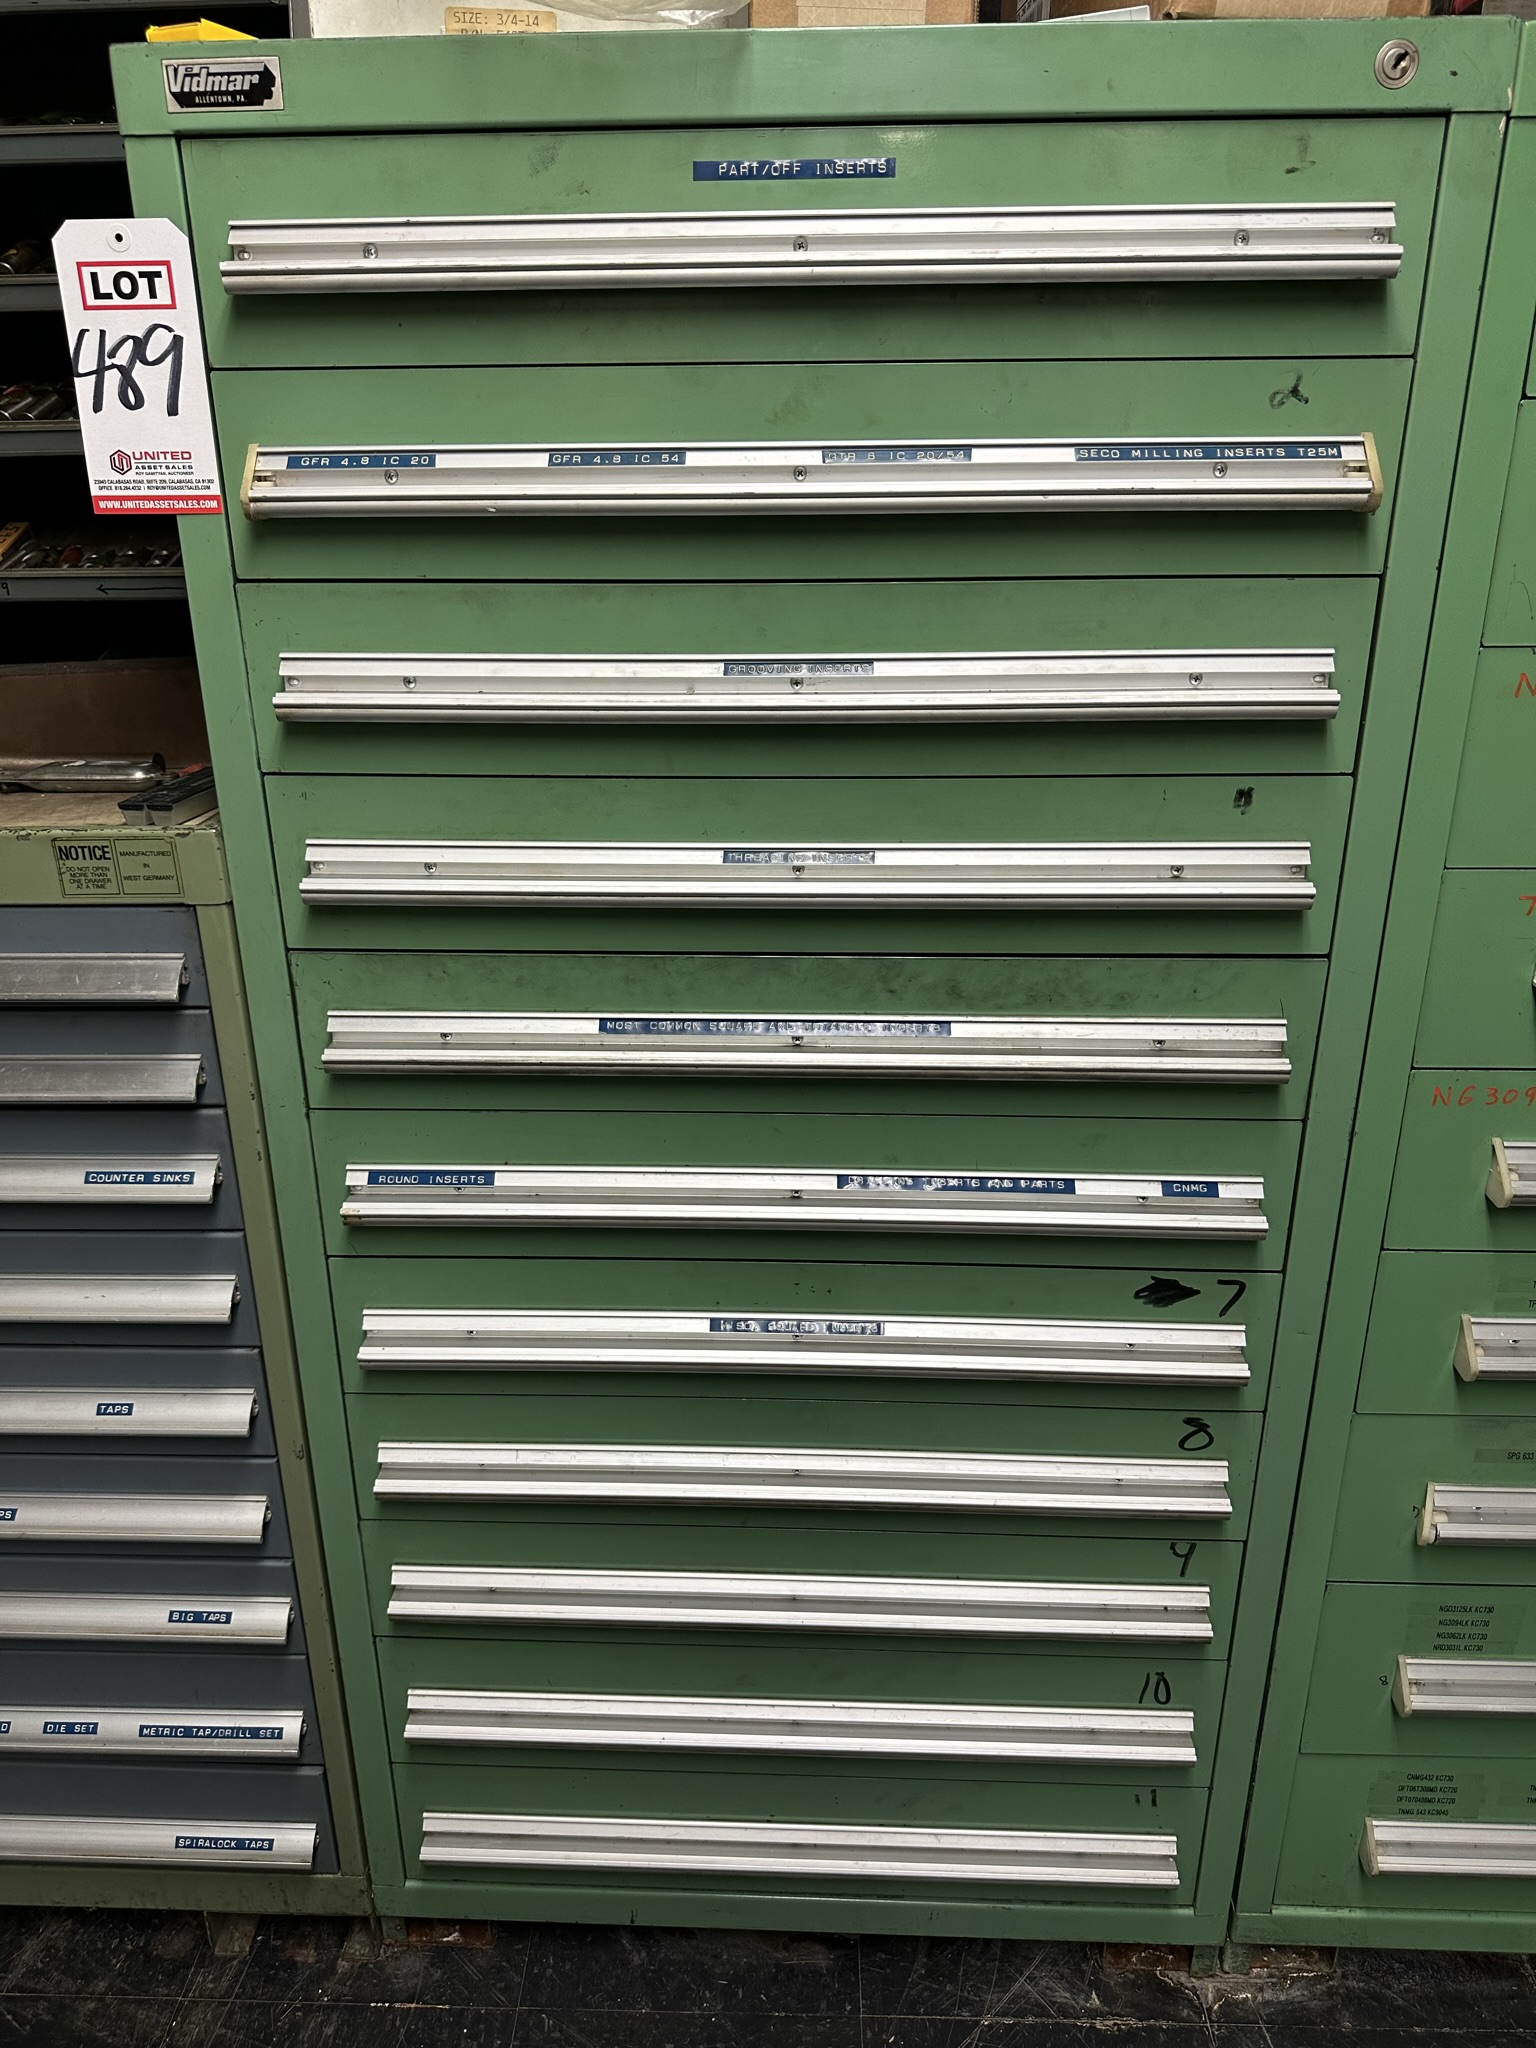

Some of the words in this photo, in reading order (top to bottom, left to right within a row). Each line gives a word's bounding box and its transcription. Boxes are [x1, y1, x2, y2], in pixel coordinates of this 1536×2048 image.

[453, 11, 488, 25] SIZE:
[497, 13, 540, 27] 3/4-14
[166, 63, 260, 93] Vidmar
[195, 95, 235, 104] ALLENTOWN,
[236, 94, 248, 103] PA.
[719, 162, 801, 176] PART/OFF
[816, 160, 888, 175] INSERTS
[91, 271, 162, 300] LOT
[73, 323, 184, 416] 489
[132, 451, 193, 460] UNITED
[867, 451, 876, 460] 6
[889, 451, 906, 460] IC
[916, 450, 965, 460] 20/54
[1079, 449, 1120, 458] SECO
[1131, 448, 1203, 458] MILLING
[1216, 447, 1286, 457] INSERTS
[1297, 447, 1339, 457] T25M
[300, 457, 330, 466] GFR
[341, 457, 370, 466] 4.8
[382, 456, 400, 465] IC
[410, 456, 429, 465] 20
[552, 455, 581, 464] GFR
[593, 455, 622, 464] 4.8
[634, 454, 651, 463] IC
[661, 454, 679, 463] 54
[98, 500, 218, 509] WWW.UNITEDASSETSALES.COM
[728, 664, 802, 674] GROOVING
[58, 845, 112, 861] NOTICE
[607, 1021, 640, 1030] MOST
[650, 1021, 700, 1031] COMMON
[89, 1173, 145, 1183] COUNTER
[153, 1173, 191, 1183] SINKS
[378, 1175, 419, 1184] ROUND
[429, 1175, 485, 1184] INSERTS
[1021, 1179, 1066, 1190] PARTS
[1173, 1183, 1208, 1193] CNMG
[1217, 1279, 1247, 1317] 7
[100, 1404, 130, 1414] TAPS
[1178, 1417, 1215, 1451] 8
[1169, 1542, 1198, 1578] 9
[172, 1612, 195, 1622] BIG
[202, 1613, 227, 1622] TAPS
[1138, 1671, 1172, 1705] 10
[46, 1724, 67, 1733] DIE
[74, 1724, 95, 1733] SET
[142, 1727, 184, 1737] METRIC
[192, 1727, 252, 1738] TAP/DRILL
[259, 1729, 280, 1738] SET
[178, 1839, 237, 1849] SPIRALOCK
[245, 1840, 270, 1850] TAPS
